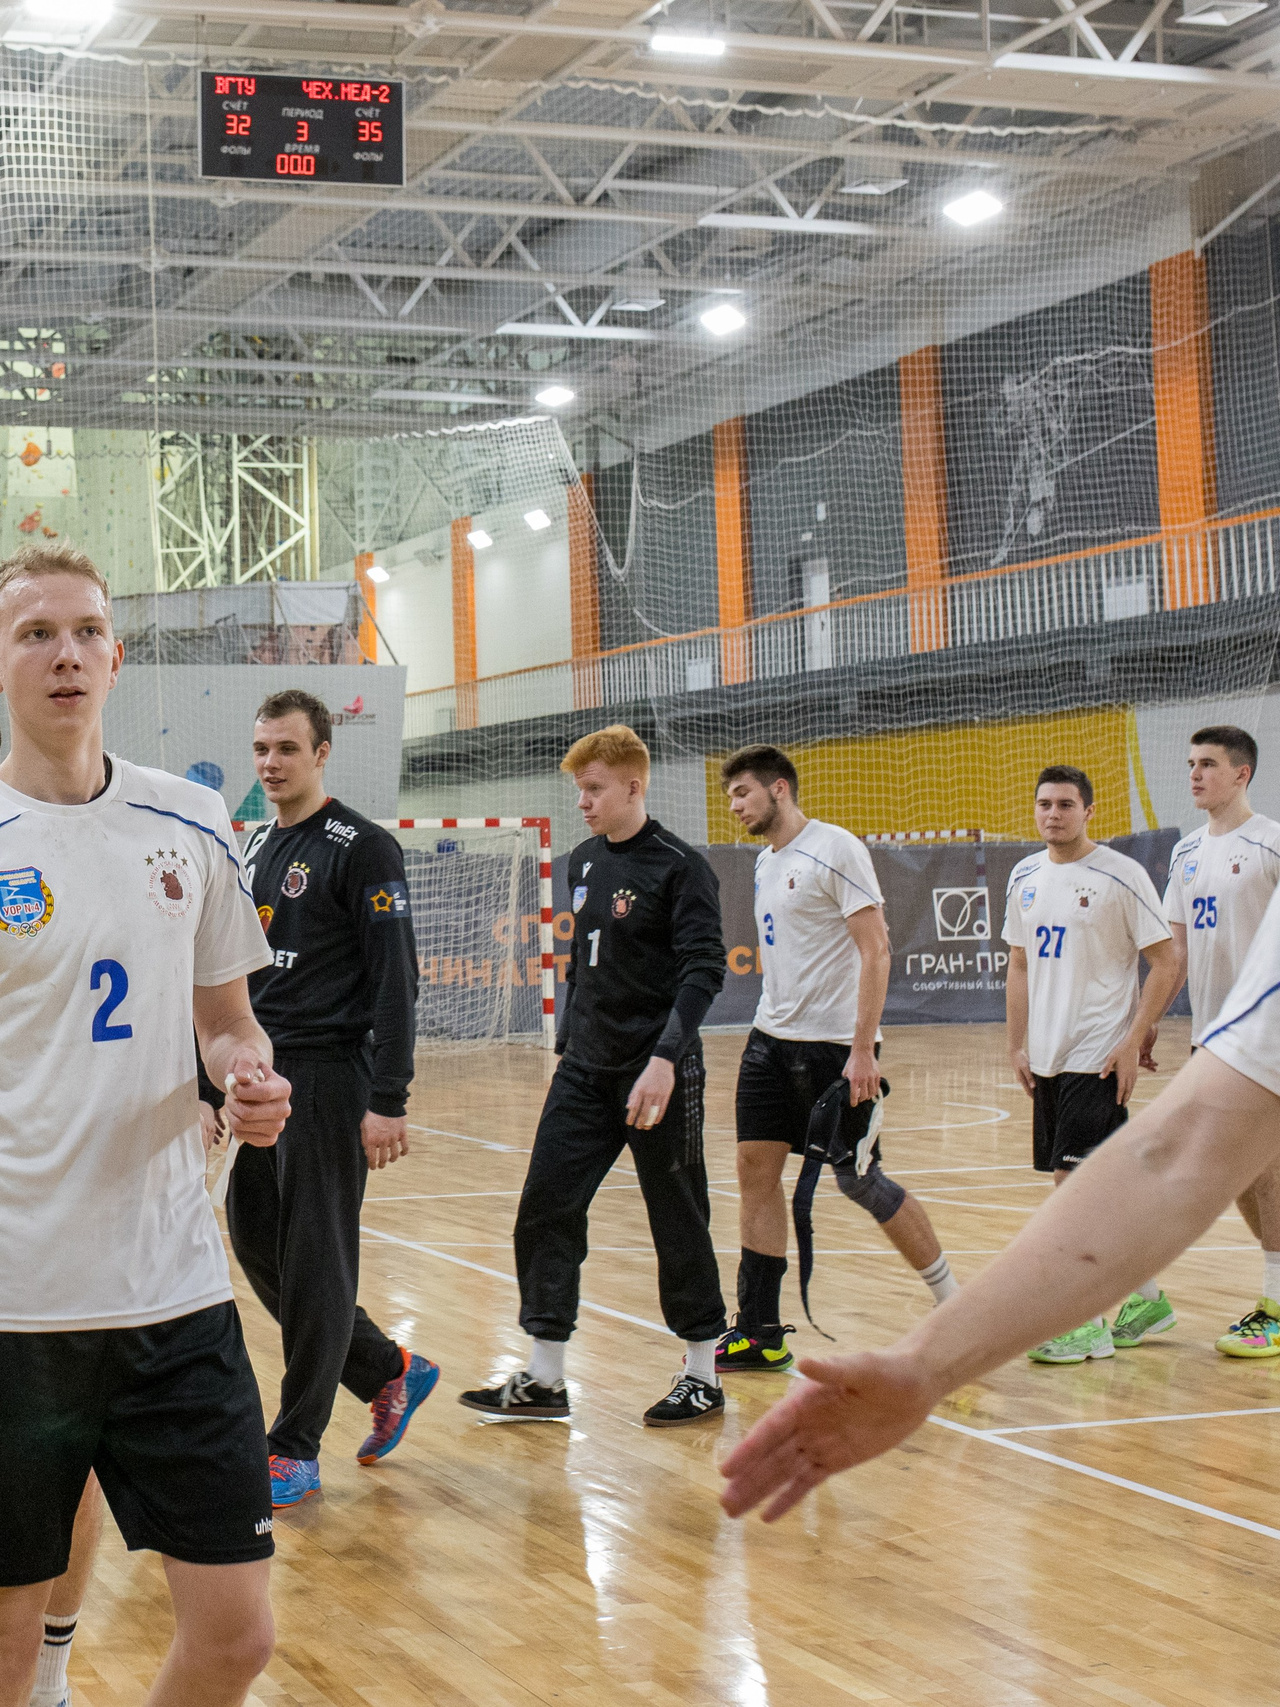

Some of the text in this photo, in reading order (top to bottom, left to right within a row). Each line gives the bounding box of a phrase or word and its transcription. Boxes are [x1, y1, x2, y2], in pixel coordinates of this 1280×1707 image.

[214, 75, 256, 96] ВГТУ
[281, 106, 324, 120] ПЕРИОД
[225, 114, 251, 136] 32
[296, 120, 309, 142] 3
[357, 120, 383, 142] 35
[220, 144, 252, 156] ФОЛЫ
[284, 142, 320, 154] ВРЕМЯ
[352, 151, 384, 162] ФОЛЫ
[324, 817, 359, 841] VinEx
[3, 904, 22, 916] УОР
[1193, 896, 1218, 930] 25
[492, 911, 575, 945] СПО
[764, 913, 775, 946] 3
[587, 929, 601, 967] 1
[1036, 926, 1066, 958] 27
[271, 949, 298, 969] ET
[906, 952, 1010, 975] ГРАН-ПР
[912, 979, 1008, 992] СПОРТИВНЫЙ ЦЕН
[90, 958, 133, 1042] 2
[255, 1516, 273, 1535] uhls
